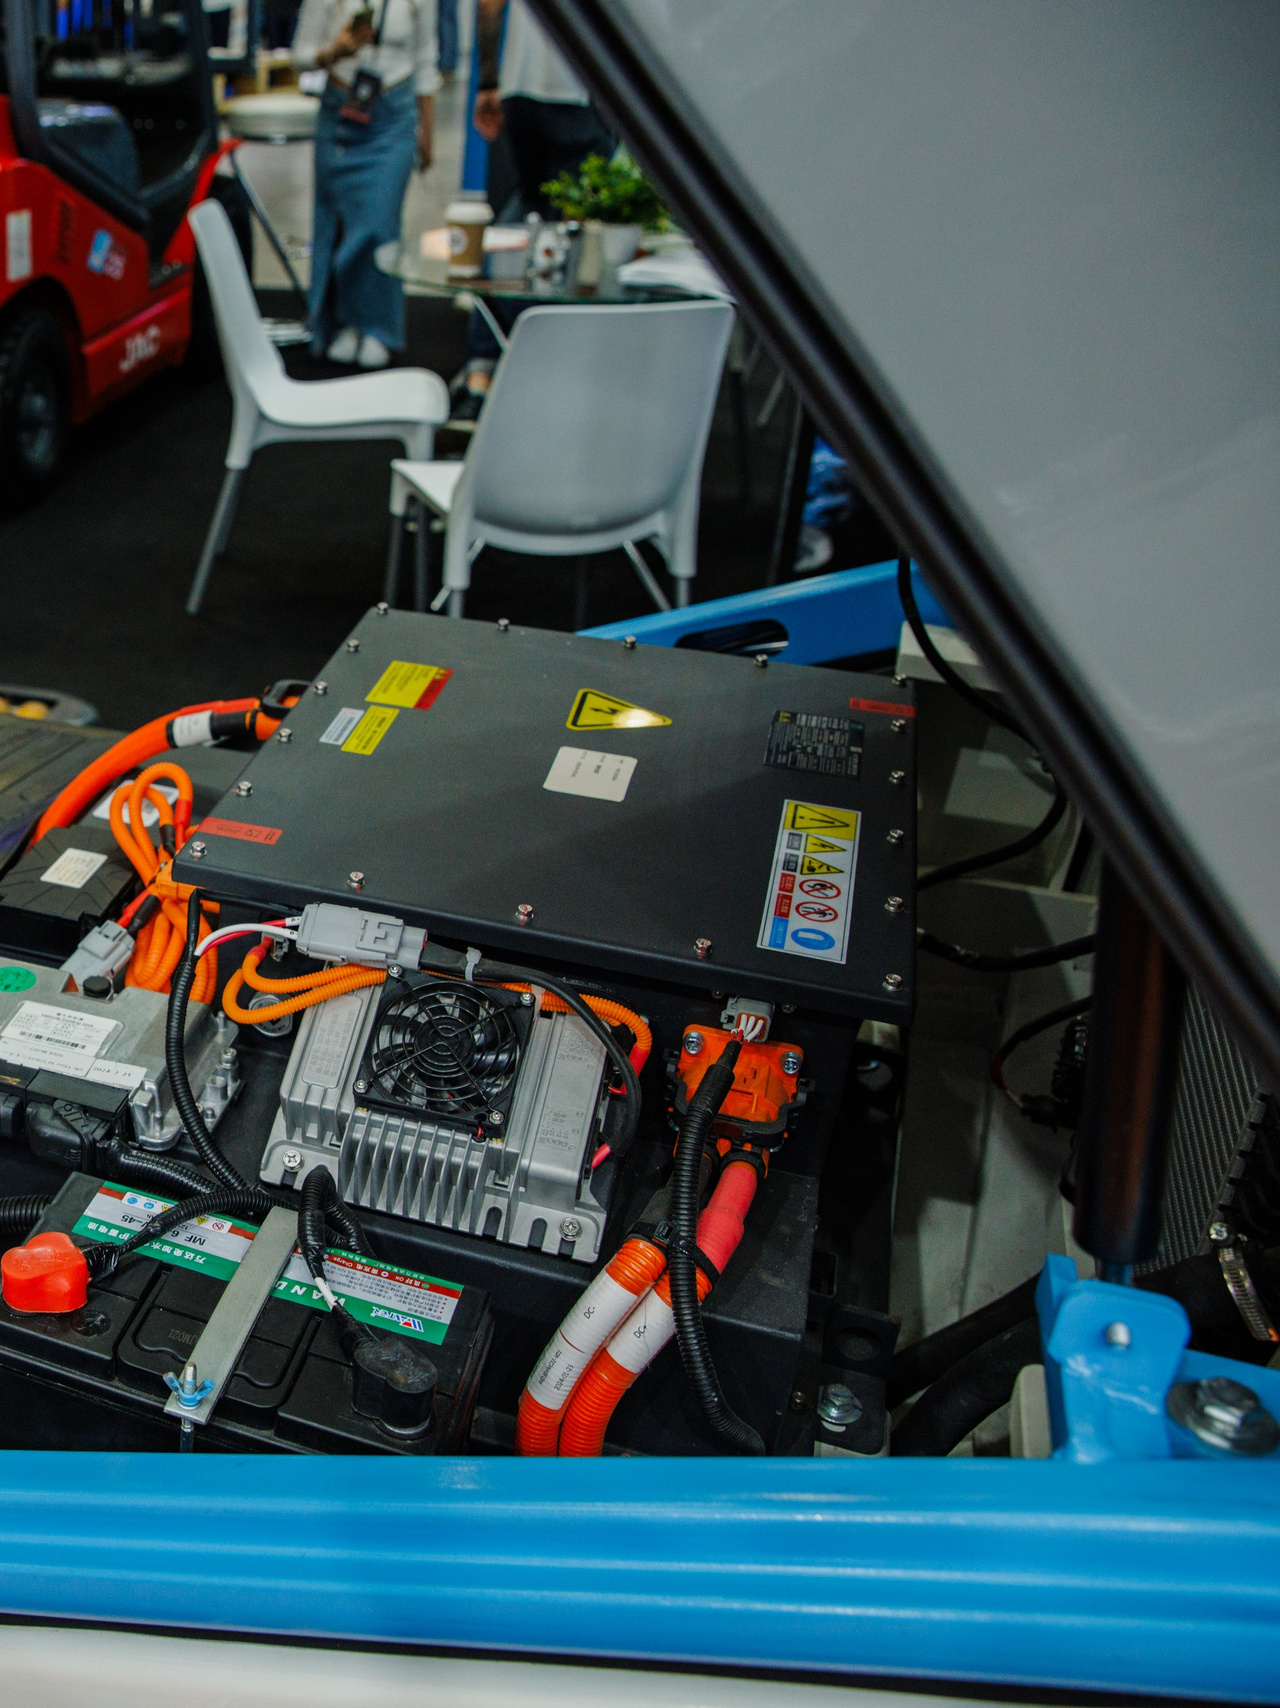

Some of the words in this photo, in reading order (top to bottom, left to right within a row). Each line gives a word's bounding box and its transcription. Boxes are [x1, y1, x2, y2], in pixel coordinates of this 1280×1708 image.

[118, 325, 161, 373] JAC
[184, 1234, 206, 1246] MF
[332, 1257, 353, 1268] Charge
[583, 1305, 596, 1320] DC-
[633, 1325, 648, 1339] DC+
